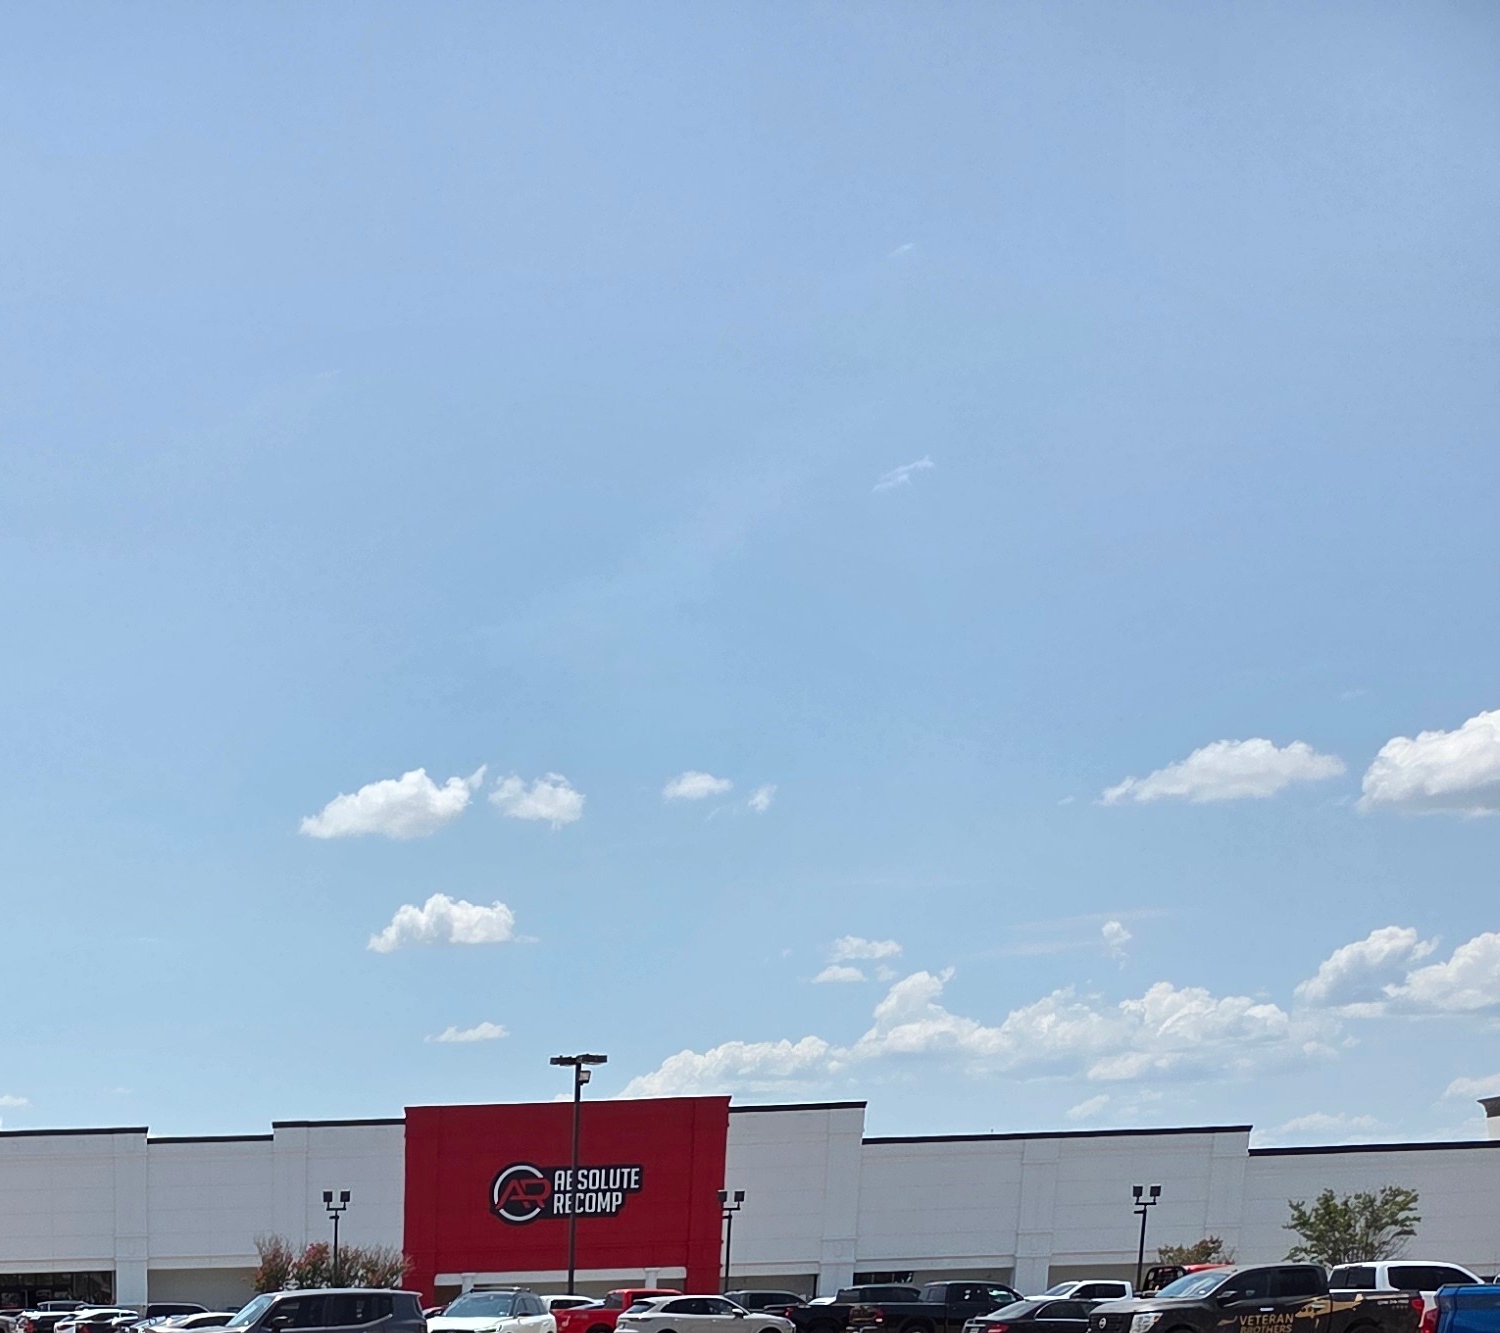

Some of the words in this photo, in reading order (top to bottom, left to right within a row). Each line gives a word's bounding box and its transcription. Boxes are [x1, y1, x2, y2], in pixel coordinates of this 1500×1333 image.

[554, 1168, 640, 1191] ABSOLUTE
[553, 1192, 622, 1215] RECOMP
[1239, 1313, 1294, 1326] VETERAN
